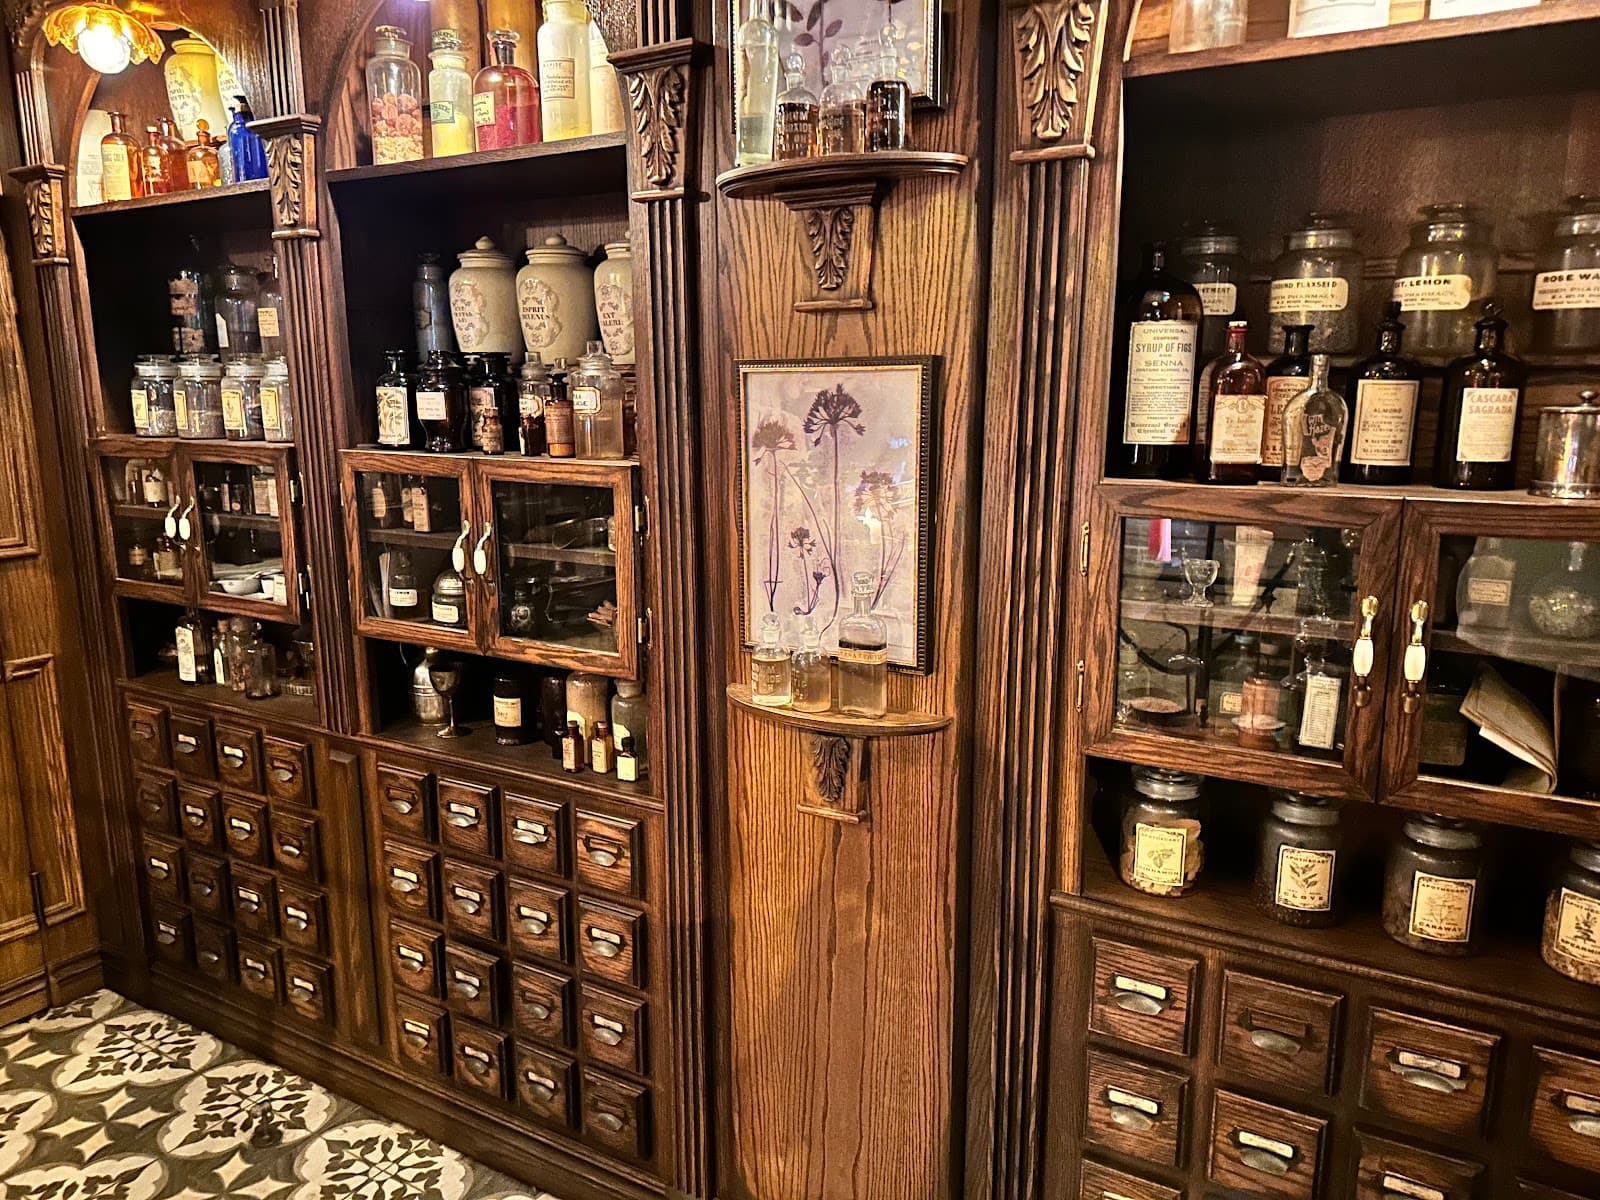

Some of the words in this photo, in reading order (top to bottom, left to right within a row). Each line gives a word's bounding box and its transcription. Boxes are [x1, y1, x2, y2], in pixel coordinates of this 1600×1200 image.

[1409, 279, 1451, 287] LEMON
[1543, 274, 1573, 283] ROSE
[1296, 281, 1337, 289] FLAXSEED
[1135, 343, 1163, 353] SYRUP
[1165, 343, 1175, 353] OF
[1177, 342, 1192, 353] FIGS
[1471, 393, 1514, 403] CASCARA
[1468, 405, 1513, 414] SAGRADA
[1141, 833, 1180, 842] APOTHECARY
[1285, 855, 1329, 864] APOTHECARY
[1138, 865, 1179, 875] CINNAMON
[1421, 883, 1469, 893] APOTHECARY
[1283, 891, 1324, 901] CLOVE
[1418, 921, 1462, 932] CARAWAY
